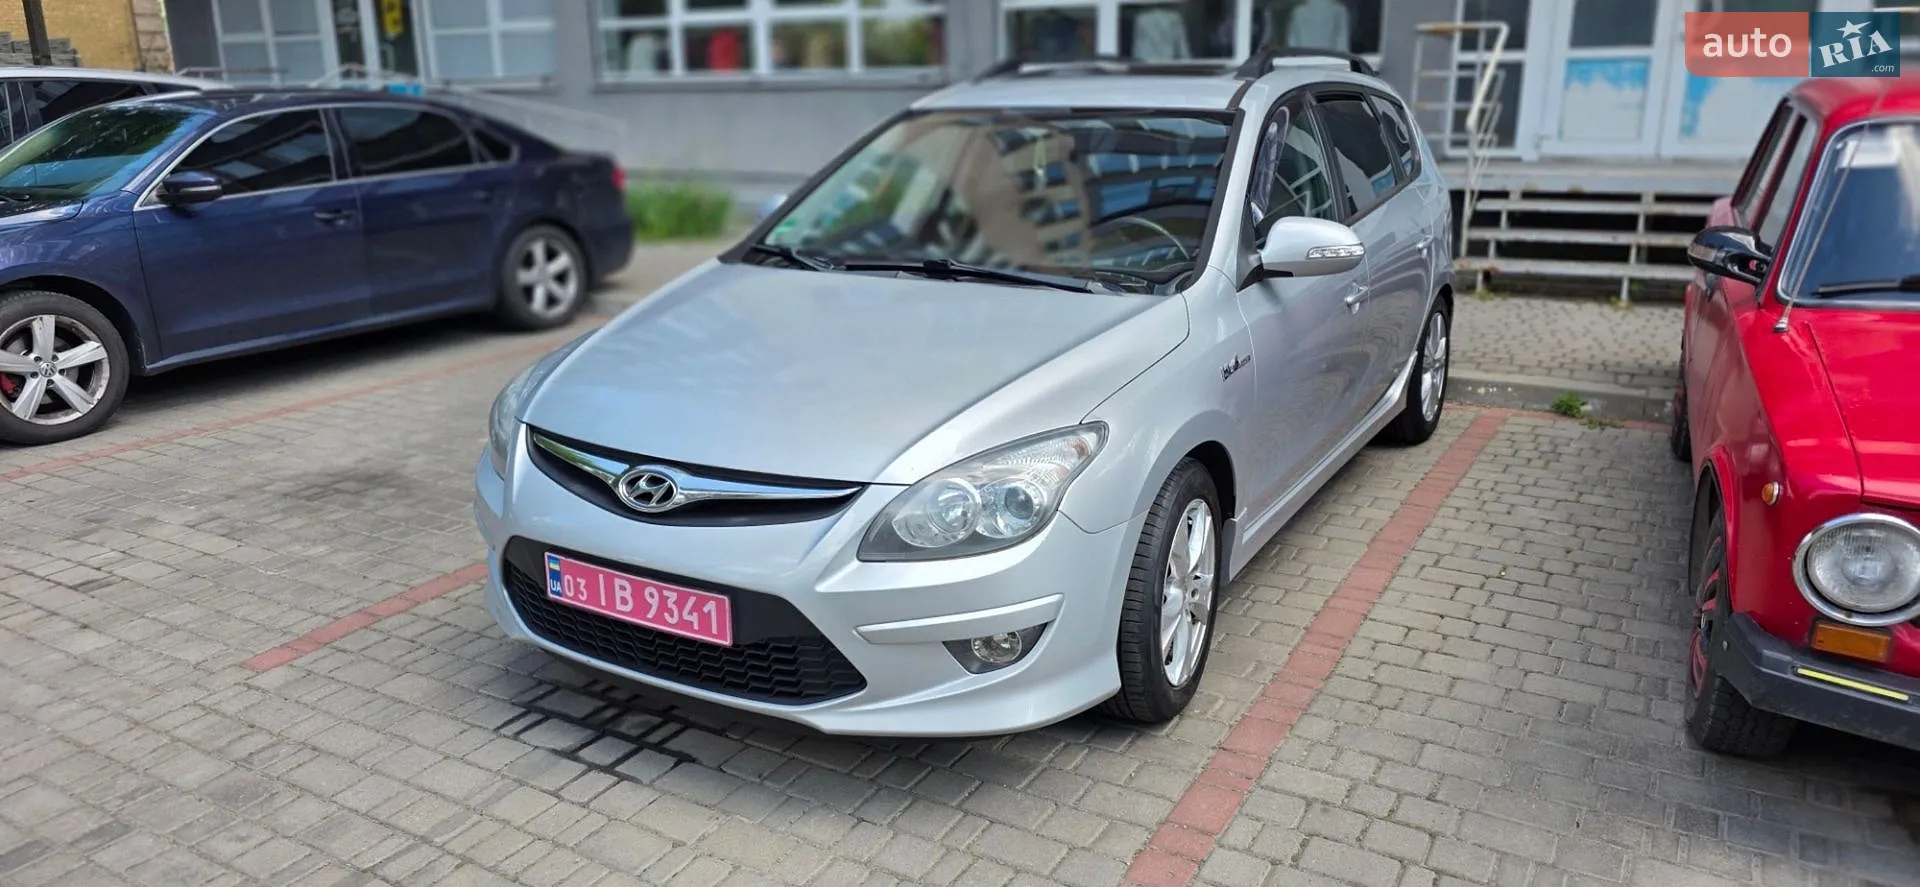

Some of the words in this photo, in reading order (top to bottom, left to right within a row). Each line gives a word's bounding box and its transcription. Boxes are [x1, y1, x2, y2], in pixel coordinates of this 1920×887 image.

[550, 580, 562, 593] UA
[564, 574, 588, 601] 03
[643, 587, 718, 635] 9341
